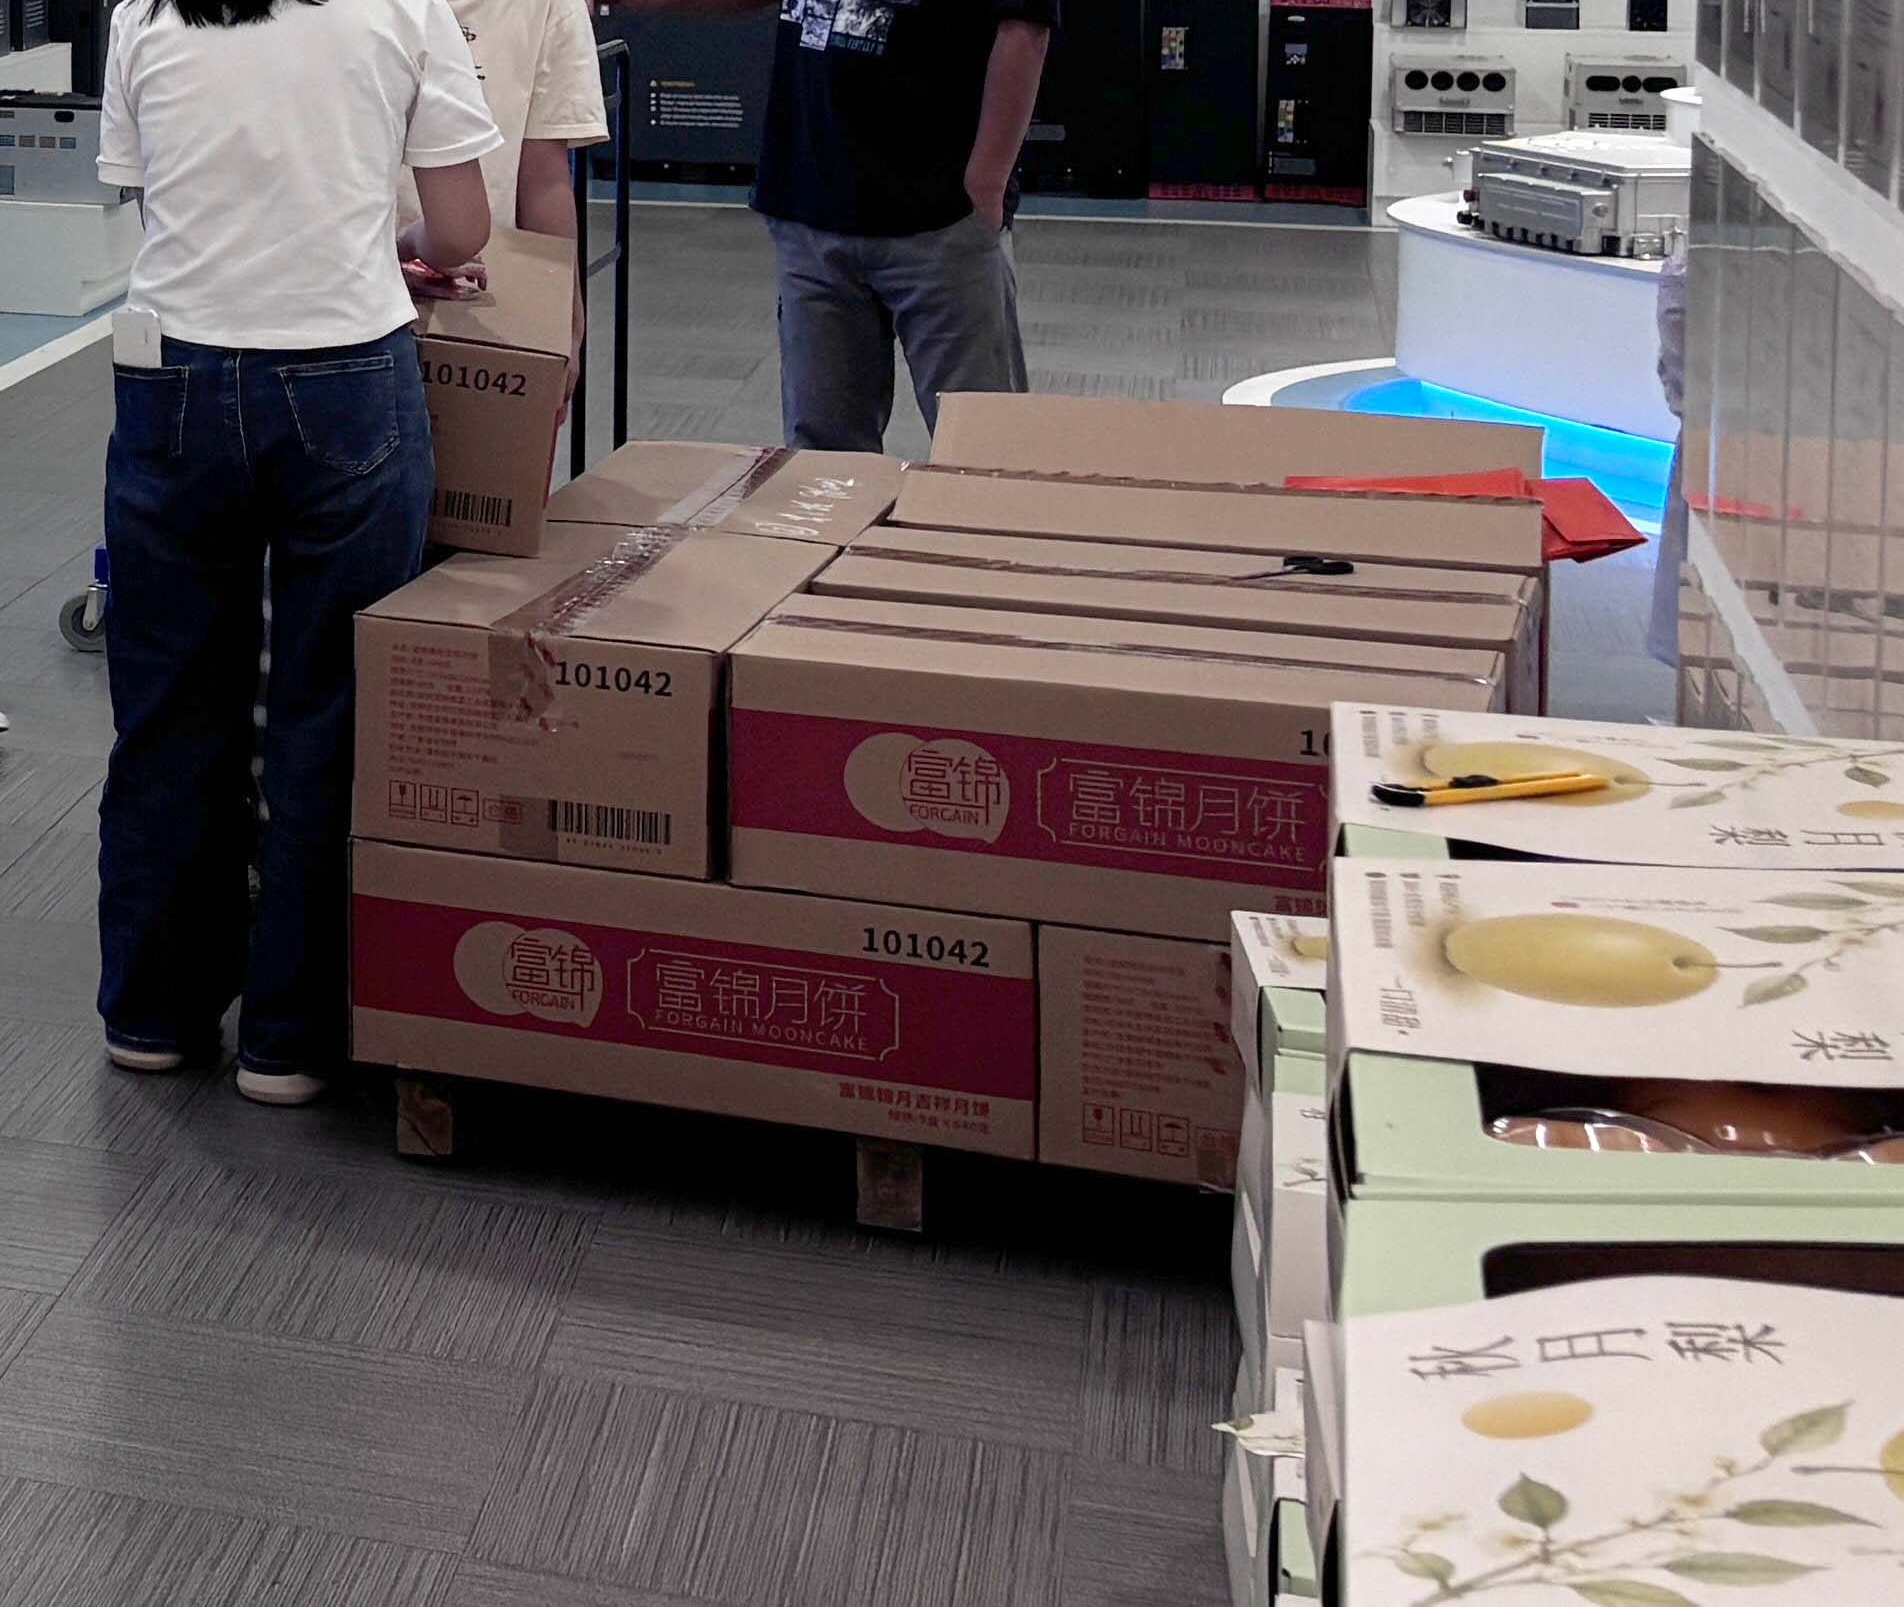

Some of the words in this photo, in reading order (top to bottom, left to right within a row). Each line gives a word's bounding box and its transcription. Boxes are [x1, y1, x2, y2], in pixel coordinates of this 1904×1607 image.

[422, 360, 527, 398] 101042
[555, 660, 673, 697] 101042
[907, 749, 1001, 807] 富锦
[909, 804, 979, 827] FORGAIN
[1068, 769, 1305, 845] 富锦月饼
[1068, 823, 1168, 847] FORGAIN
[1177, 834, 1306, 864] MOONCAKE
[510, 934, 596, 992] 富锦
[862, 926, 990, 968] 101042
[510, 989, 576, 1011] FORGAIN
[655, 958, 868, 1035] 富锦月饼
[655, 1008, 743, 1035] FORGAIN
[752, 1020, 869, 1052] MOONCAKE
[1407, 1320, 1786, 1382] 秋月梨
